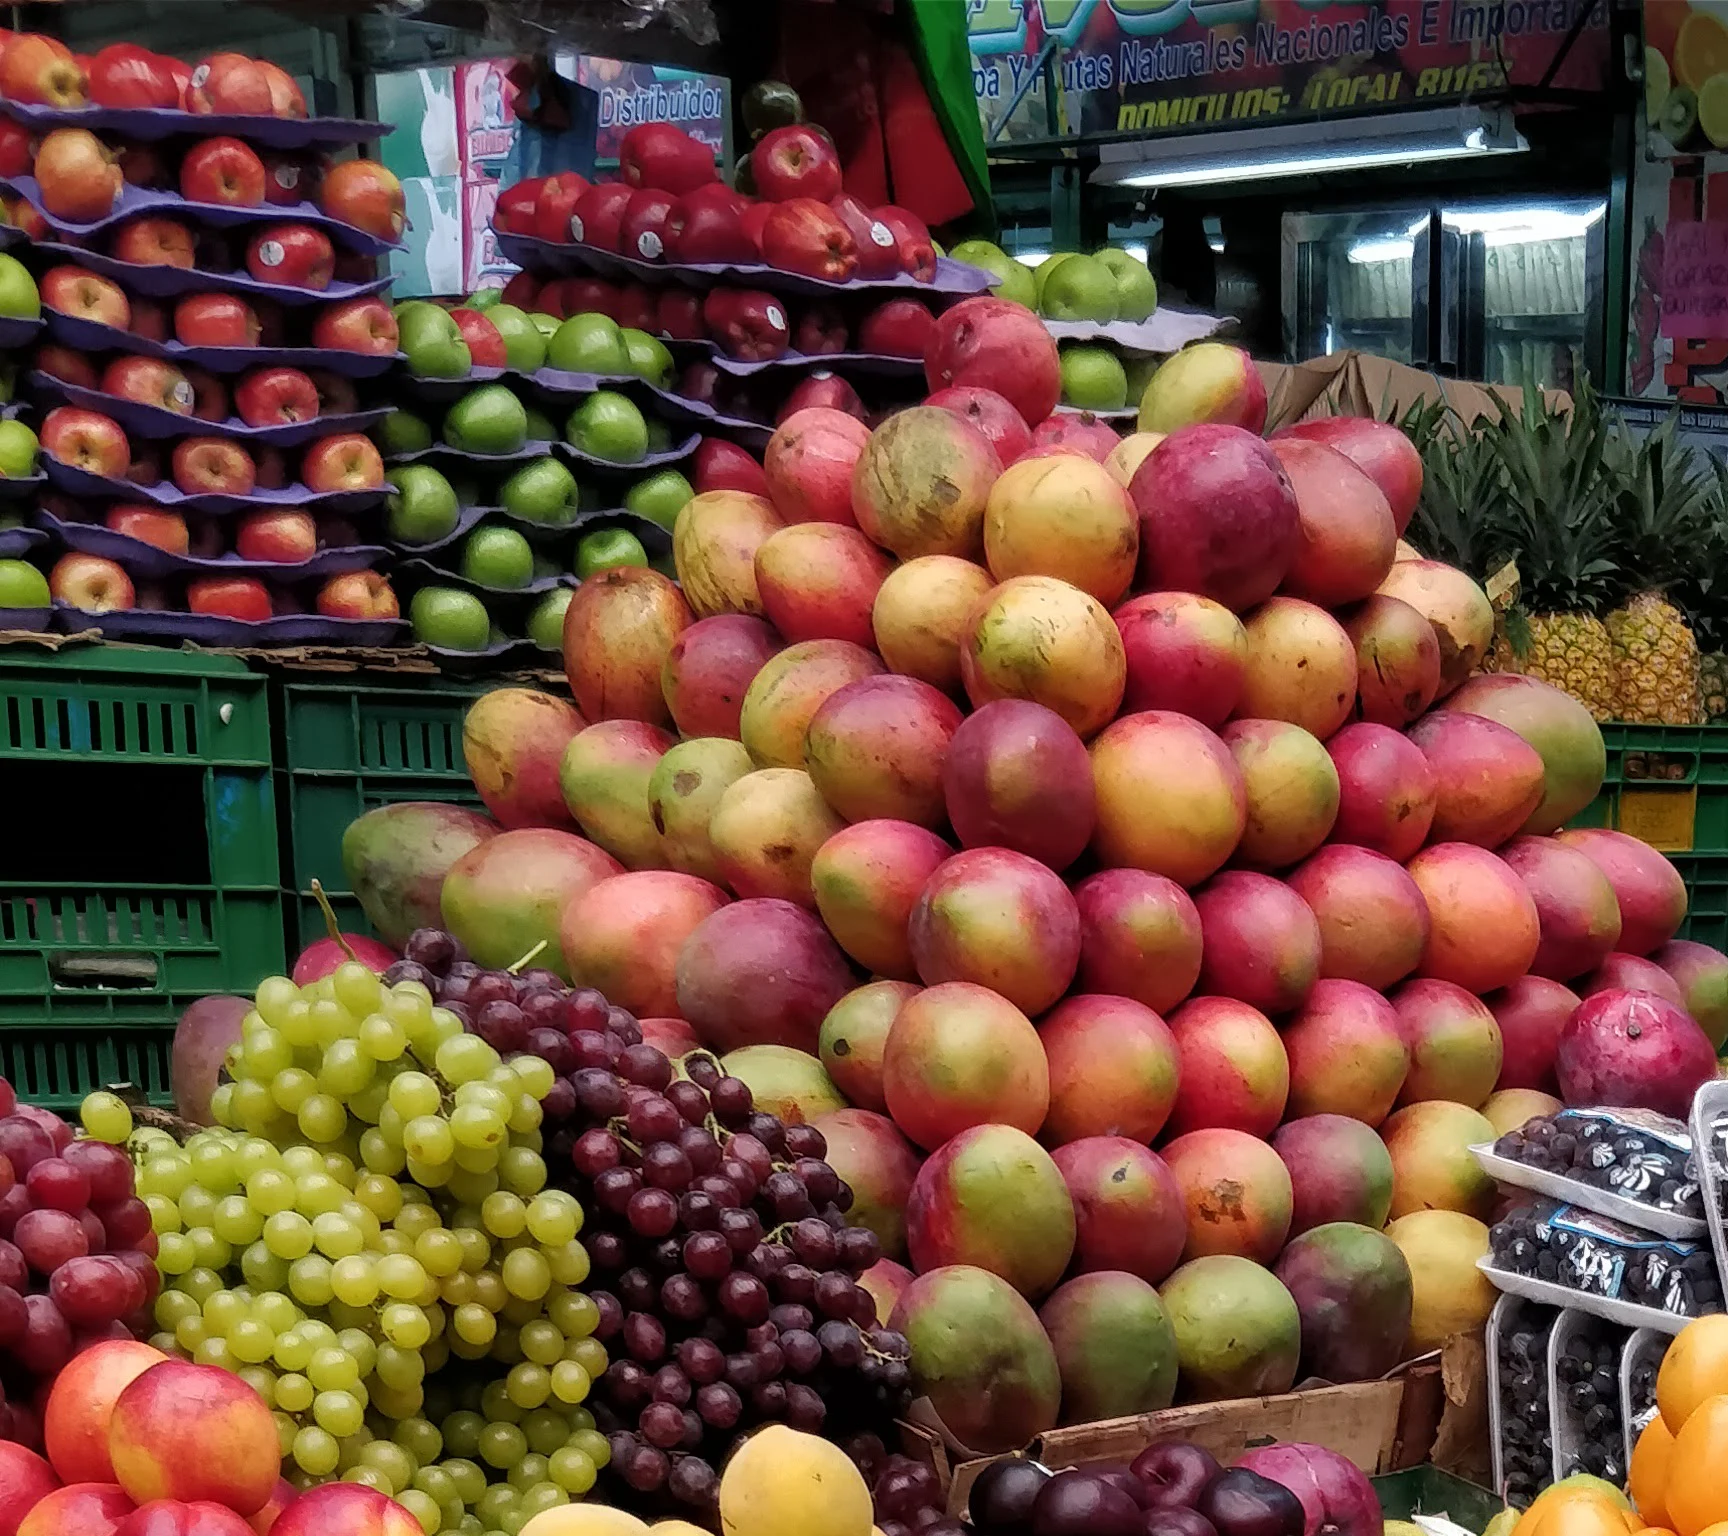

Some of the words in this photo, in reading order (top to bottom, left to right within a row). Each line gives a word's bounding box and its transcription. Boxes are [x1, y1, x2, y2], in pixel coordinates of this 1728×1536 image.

[1120, 30, 1246, 84] Naturales
[1254, 5, 1409, 67] Nacionales
[1419, 2, 1440, 46] E
